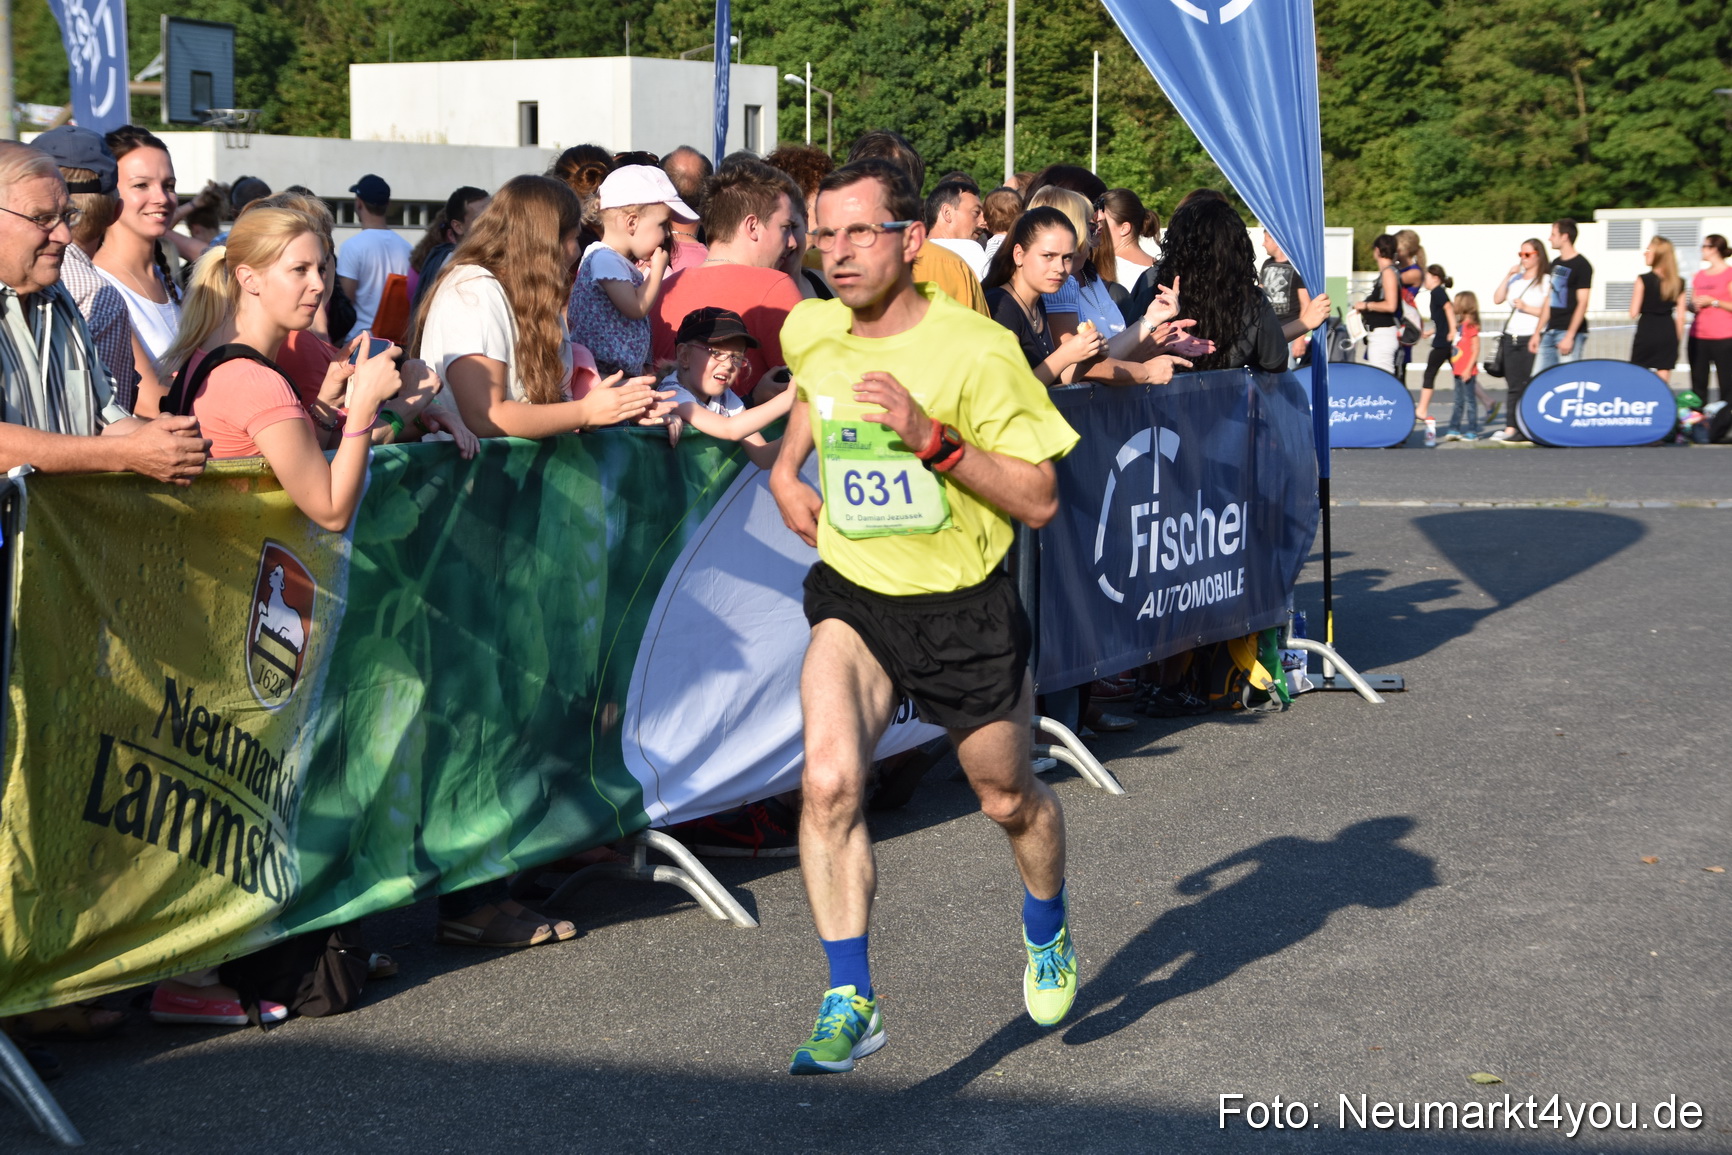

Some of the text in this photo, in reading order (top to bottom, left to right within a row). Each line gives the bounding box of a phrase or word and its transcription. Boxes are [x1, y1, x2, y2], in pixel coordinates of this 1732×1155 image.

[1560, 397, 1659, 417] Fischer
[1570, 417, 1653, 428] AUTOMOBILE
[843, 469, 913, 506] 631
[887, 512, 923, 521] Jezussek
[1136, 567, 1245, 620] AUTOMOBILE
[255, 664, 286, 699] 1628
